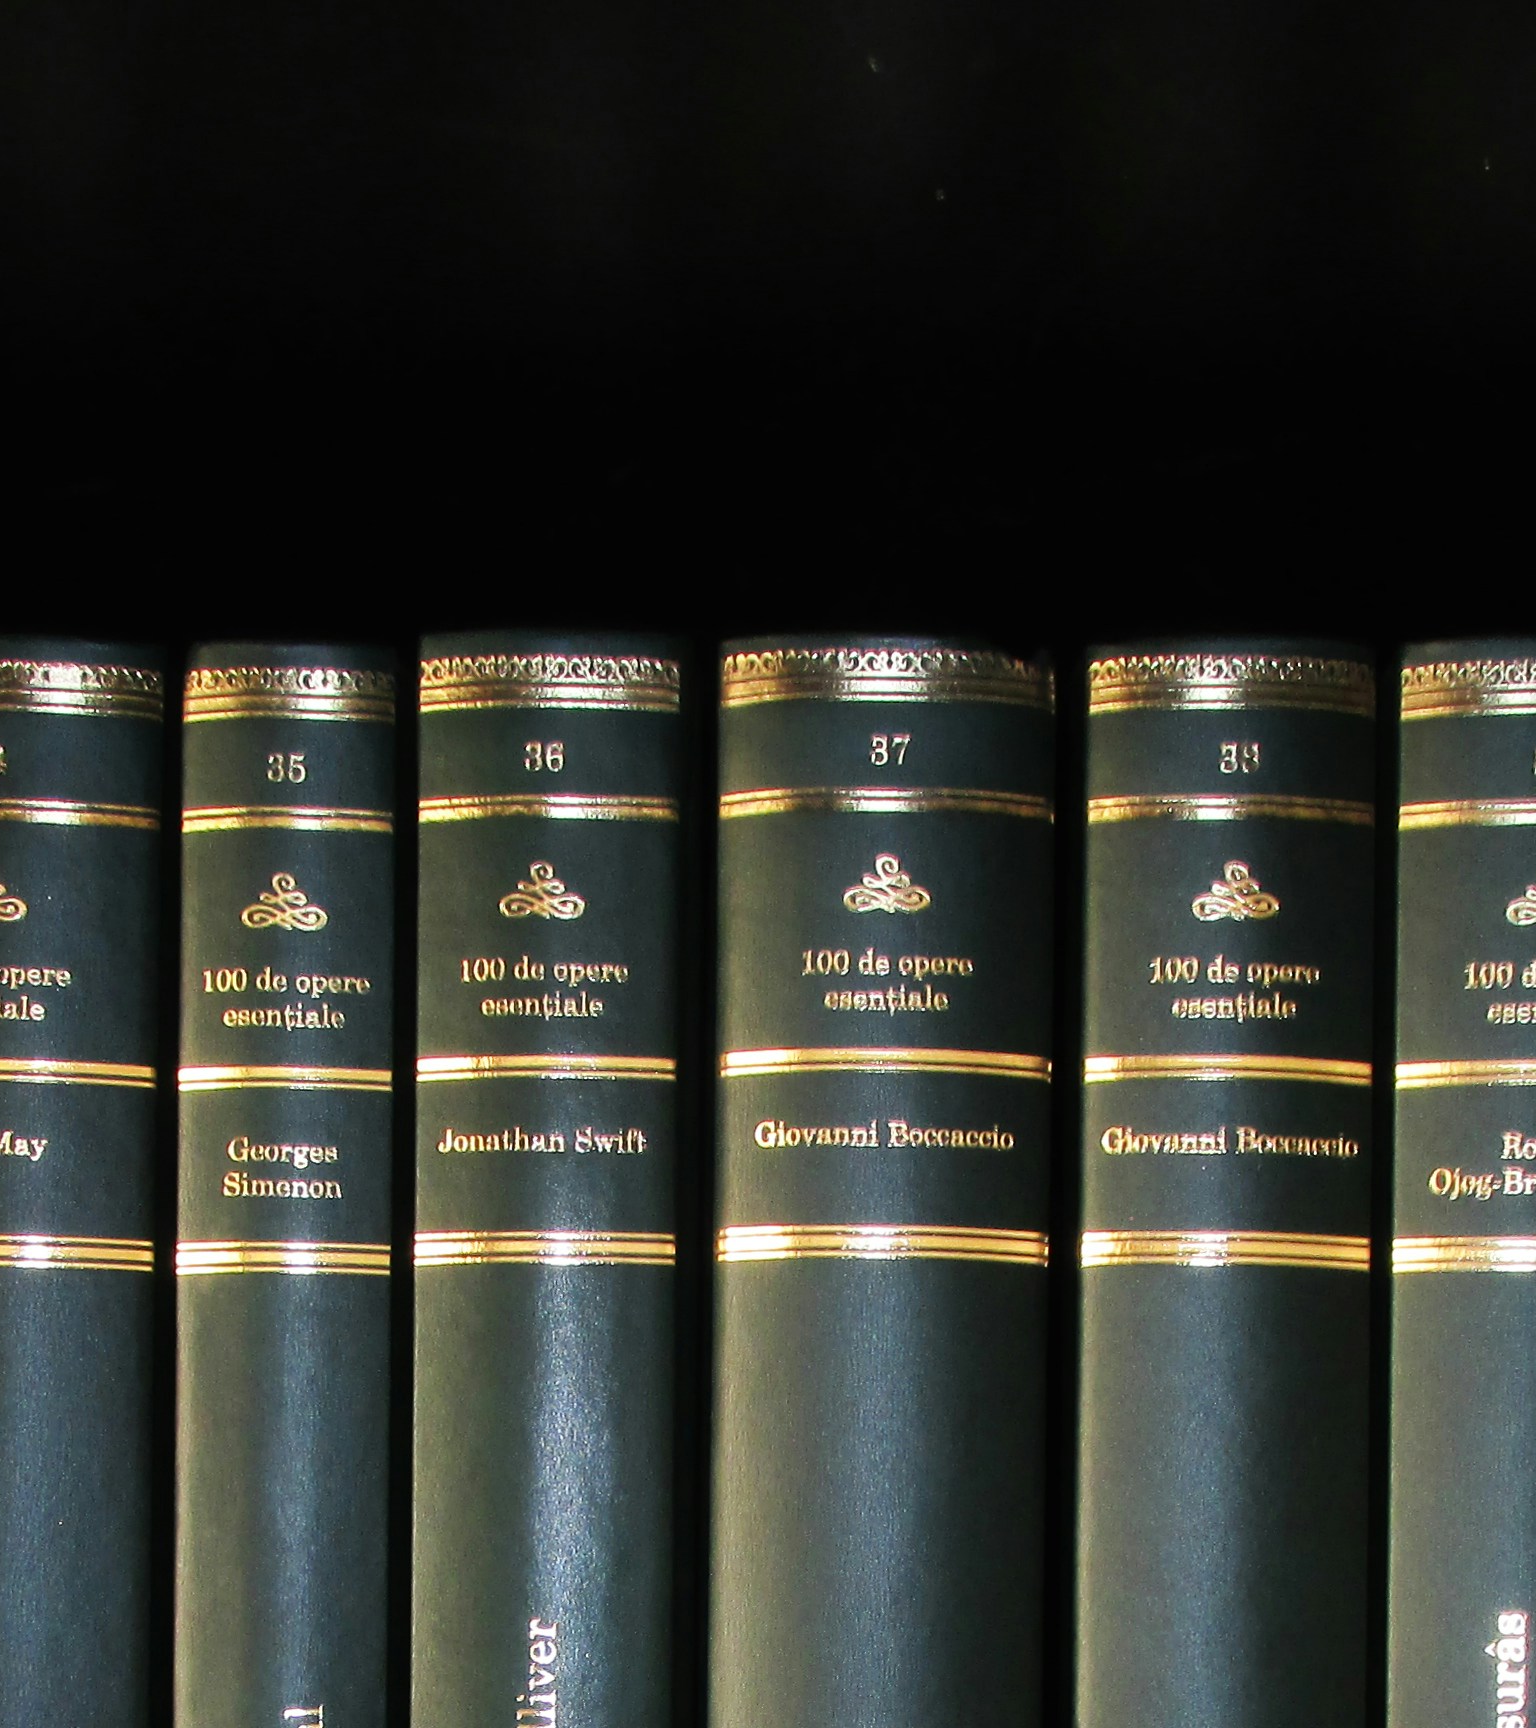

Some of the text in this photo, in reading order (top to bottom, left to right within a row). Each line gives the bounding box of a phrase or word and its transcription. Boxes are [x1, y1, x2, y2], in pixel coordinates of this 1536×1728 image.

[525, 741, 563, 772] 36
[871, 734, 910, 765] 37
[267, 752, 306, 783] 35
[461, 957, 505, 982] 100
[514, 955, 544, 980] de
[802, 949, 849, 976] 100
[858, 947, 889, 976] de
[203, 966, 370, 998] 100 de opere
[438, 1126, 647, 1154] Jonathan Swift
[755, 1119, 879, 1148] Giovanni
[1102, 1126, 1226, 1154] Giovanni
[228, 1137, 338, 1169] Georges
[223, 1171, 342, 1198] Simenon
